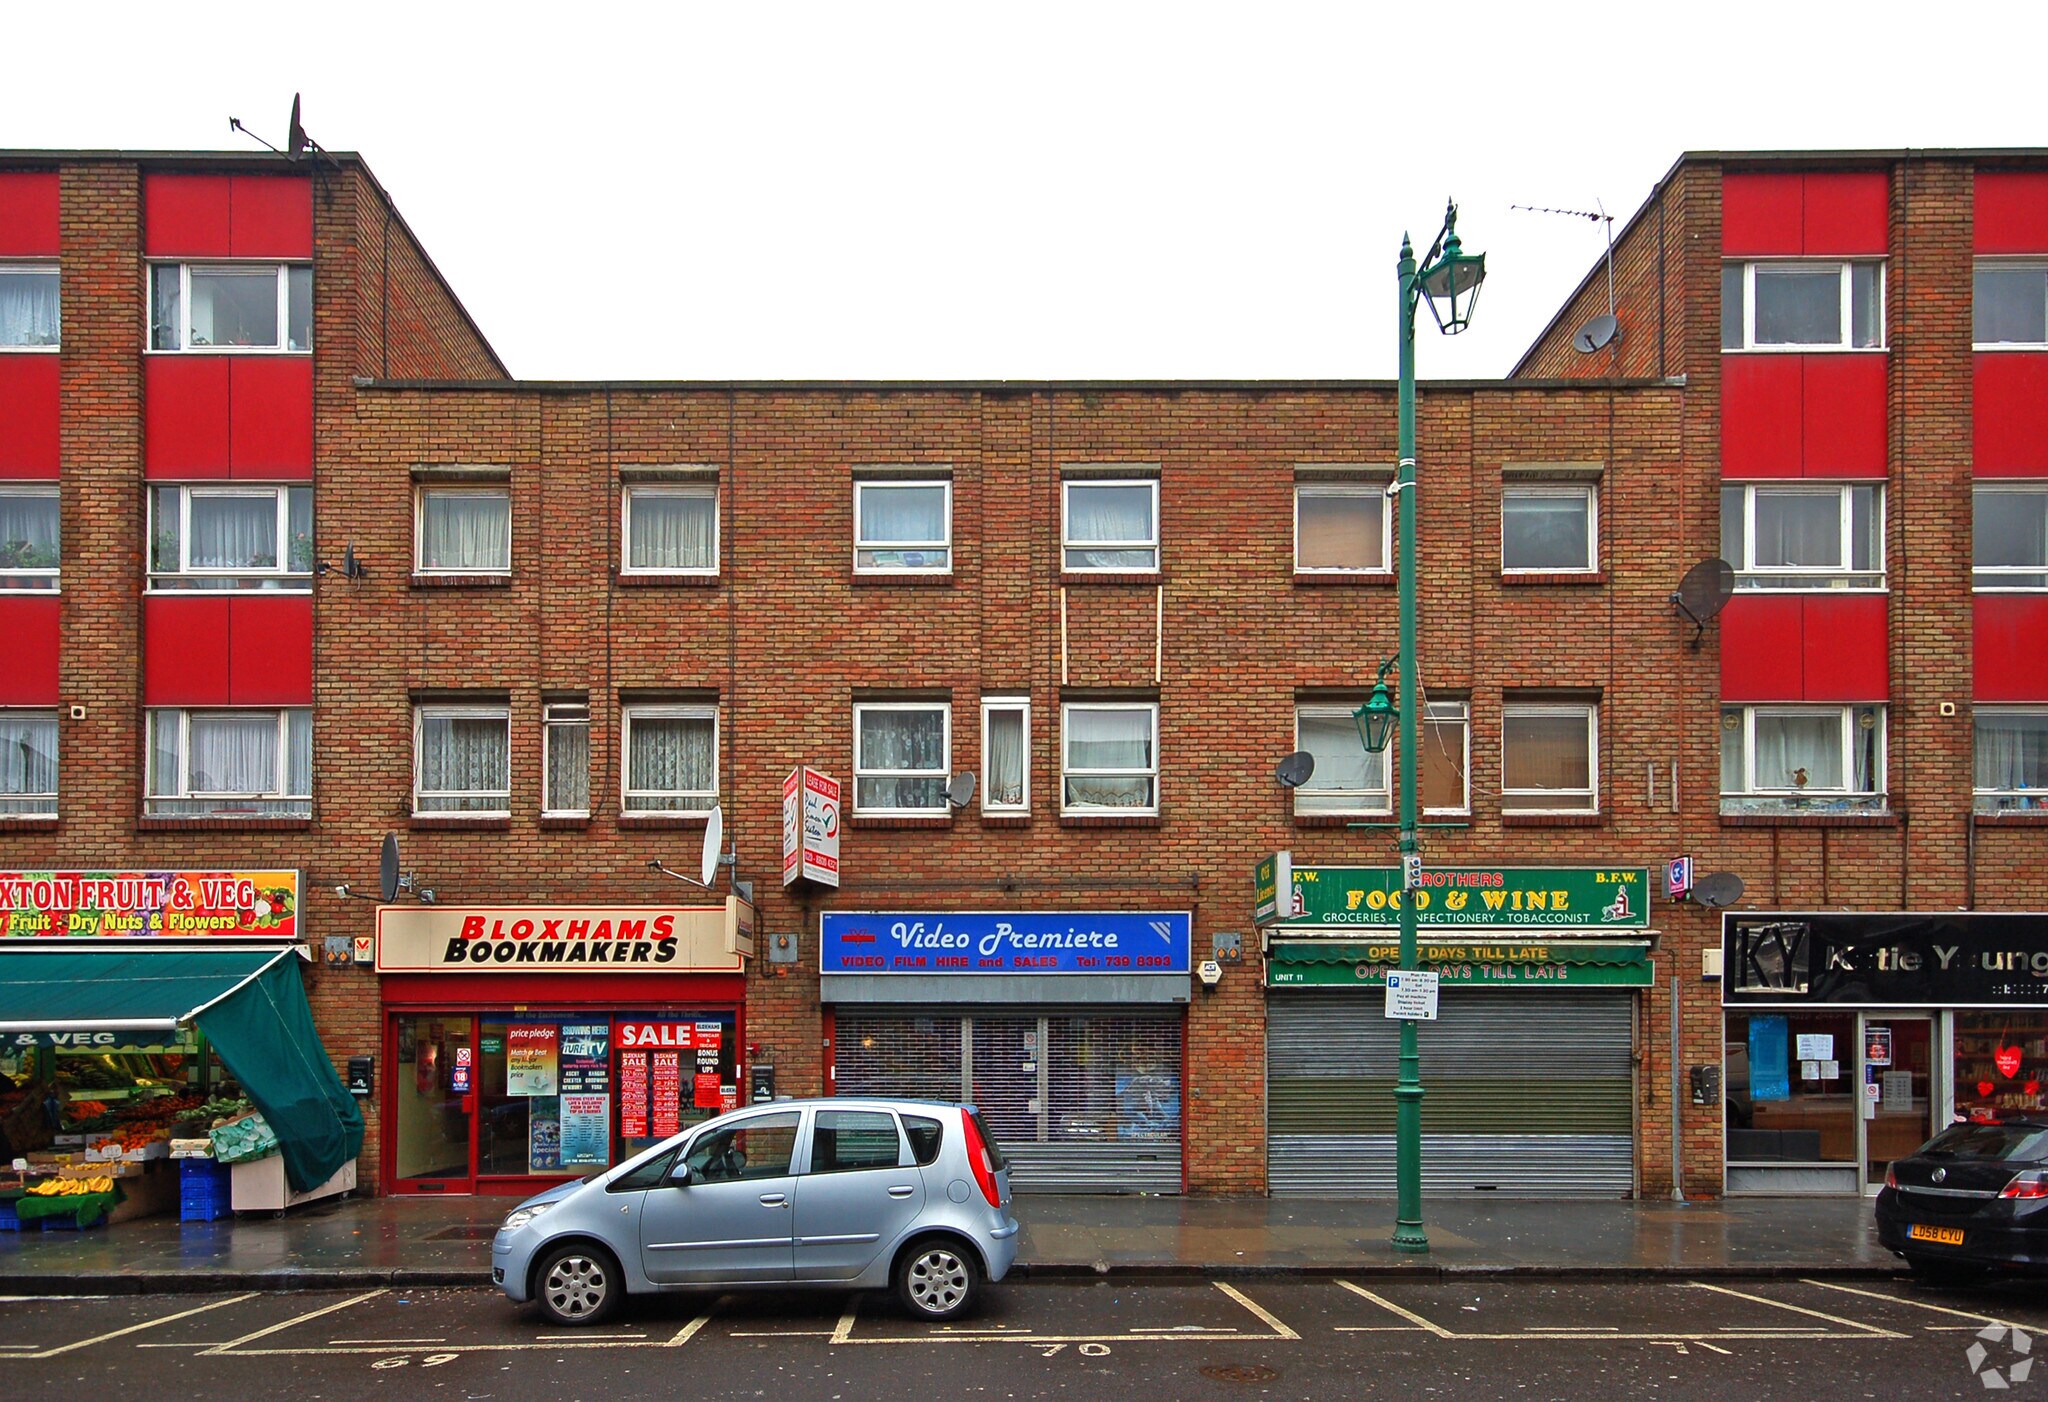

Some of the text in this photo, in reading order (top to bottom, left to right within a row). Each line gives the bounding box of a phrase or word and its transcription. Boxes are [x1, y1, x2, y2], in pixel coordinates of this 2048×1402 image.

[1421, 872, 1504, 887] ROTHERS
[1595, 872, 1637, 883] B.F.W.
[80, 879, 164, 910] FRUIT
[172, 879, 194, 910] &
[200, 879, 254, 910] VEG
[1445, 890, 1468, 910] &
[1481, 890, 1569, 911] WINE
[9, 913, 51, 931] Fruit
[69, 913, 99, 934] Dry
[104, 913, 144, 930] Nuts
[149, 913, 163, 930] &
[168, 912, 236, 930] Flowers
[1322, 913, 1386, 922] GROCERIES
[1396, 913, 1496, 923] CNFECTIONERY
[1506, 913, 1591, 923] TOBACCONIST
[460, 915, 675, 941] BLOXHAMS
[890, 922, 1119, 956] Video Premiere
[443, 937, 679, 963] BOOKMAKERS
[1369, 947, 1399, 958] OPE
[1428, 947, 1466, 959] DAYS
[1472, 947, 1505, 959] TILL
[1509, 947, 1548, 959] LATE
[1740, 927, 1806, 987] KY
[841, 956, 885, 967] VIDEO
[894, 956, 927, 967] FILM
[936, 956, 969, 967] HIRE
[978, 956, 1003, 967] and
[1013, 956, 1058, 967] SALES
[1105, 956, 1131, 967] 739
[1136, 956, 1171, 967] 8393
[1825, 945, 2048, 977] Ktie Yung
[1355, 964, 1400, 979] OPE
[1481, 965, 1517, 979] TILL
[1524, 965, 1568, 979] LATE
[15, 1032, 116, 1045] & VEG
[510, 1028, 555, 1039] price pledge
[622, 1025, 691, 1046] SALE
[588, 1042, 607, 1055] TV
[697, 1049, 719, 1057] BONUS
[622, 1058, 647, 1066] SALE
[654, 1058, 678, 1066] SALE
[1912, 1225, 1962, 1241] LD58 CYU
[1031, 1343, 1111, 1357] 70
